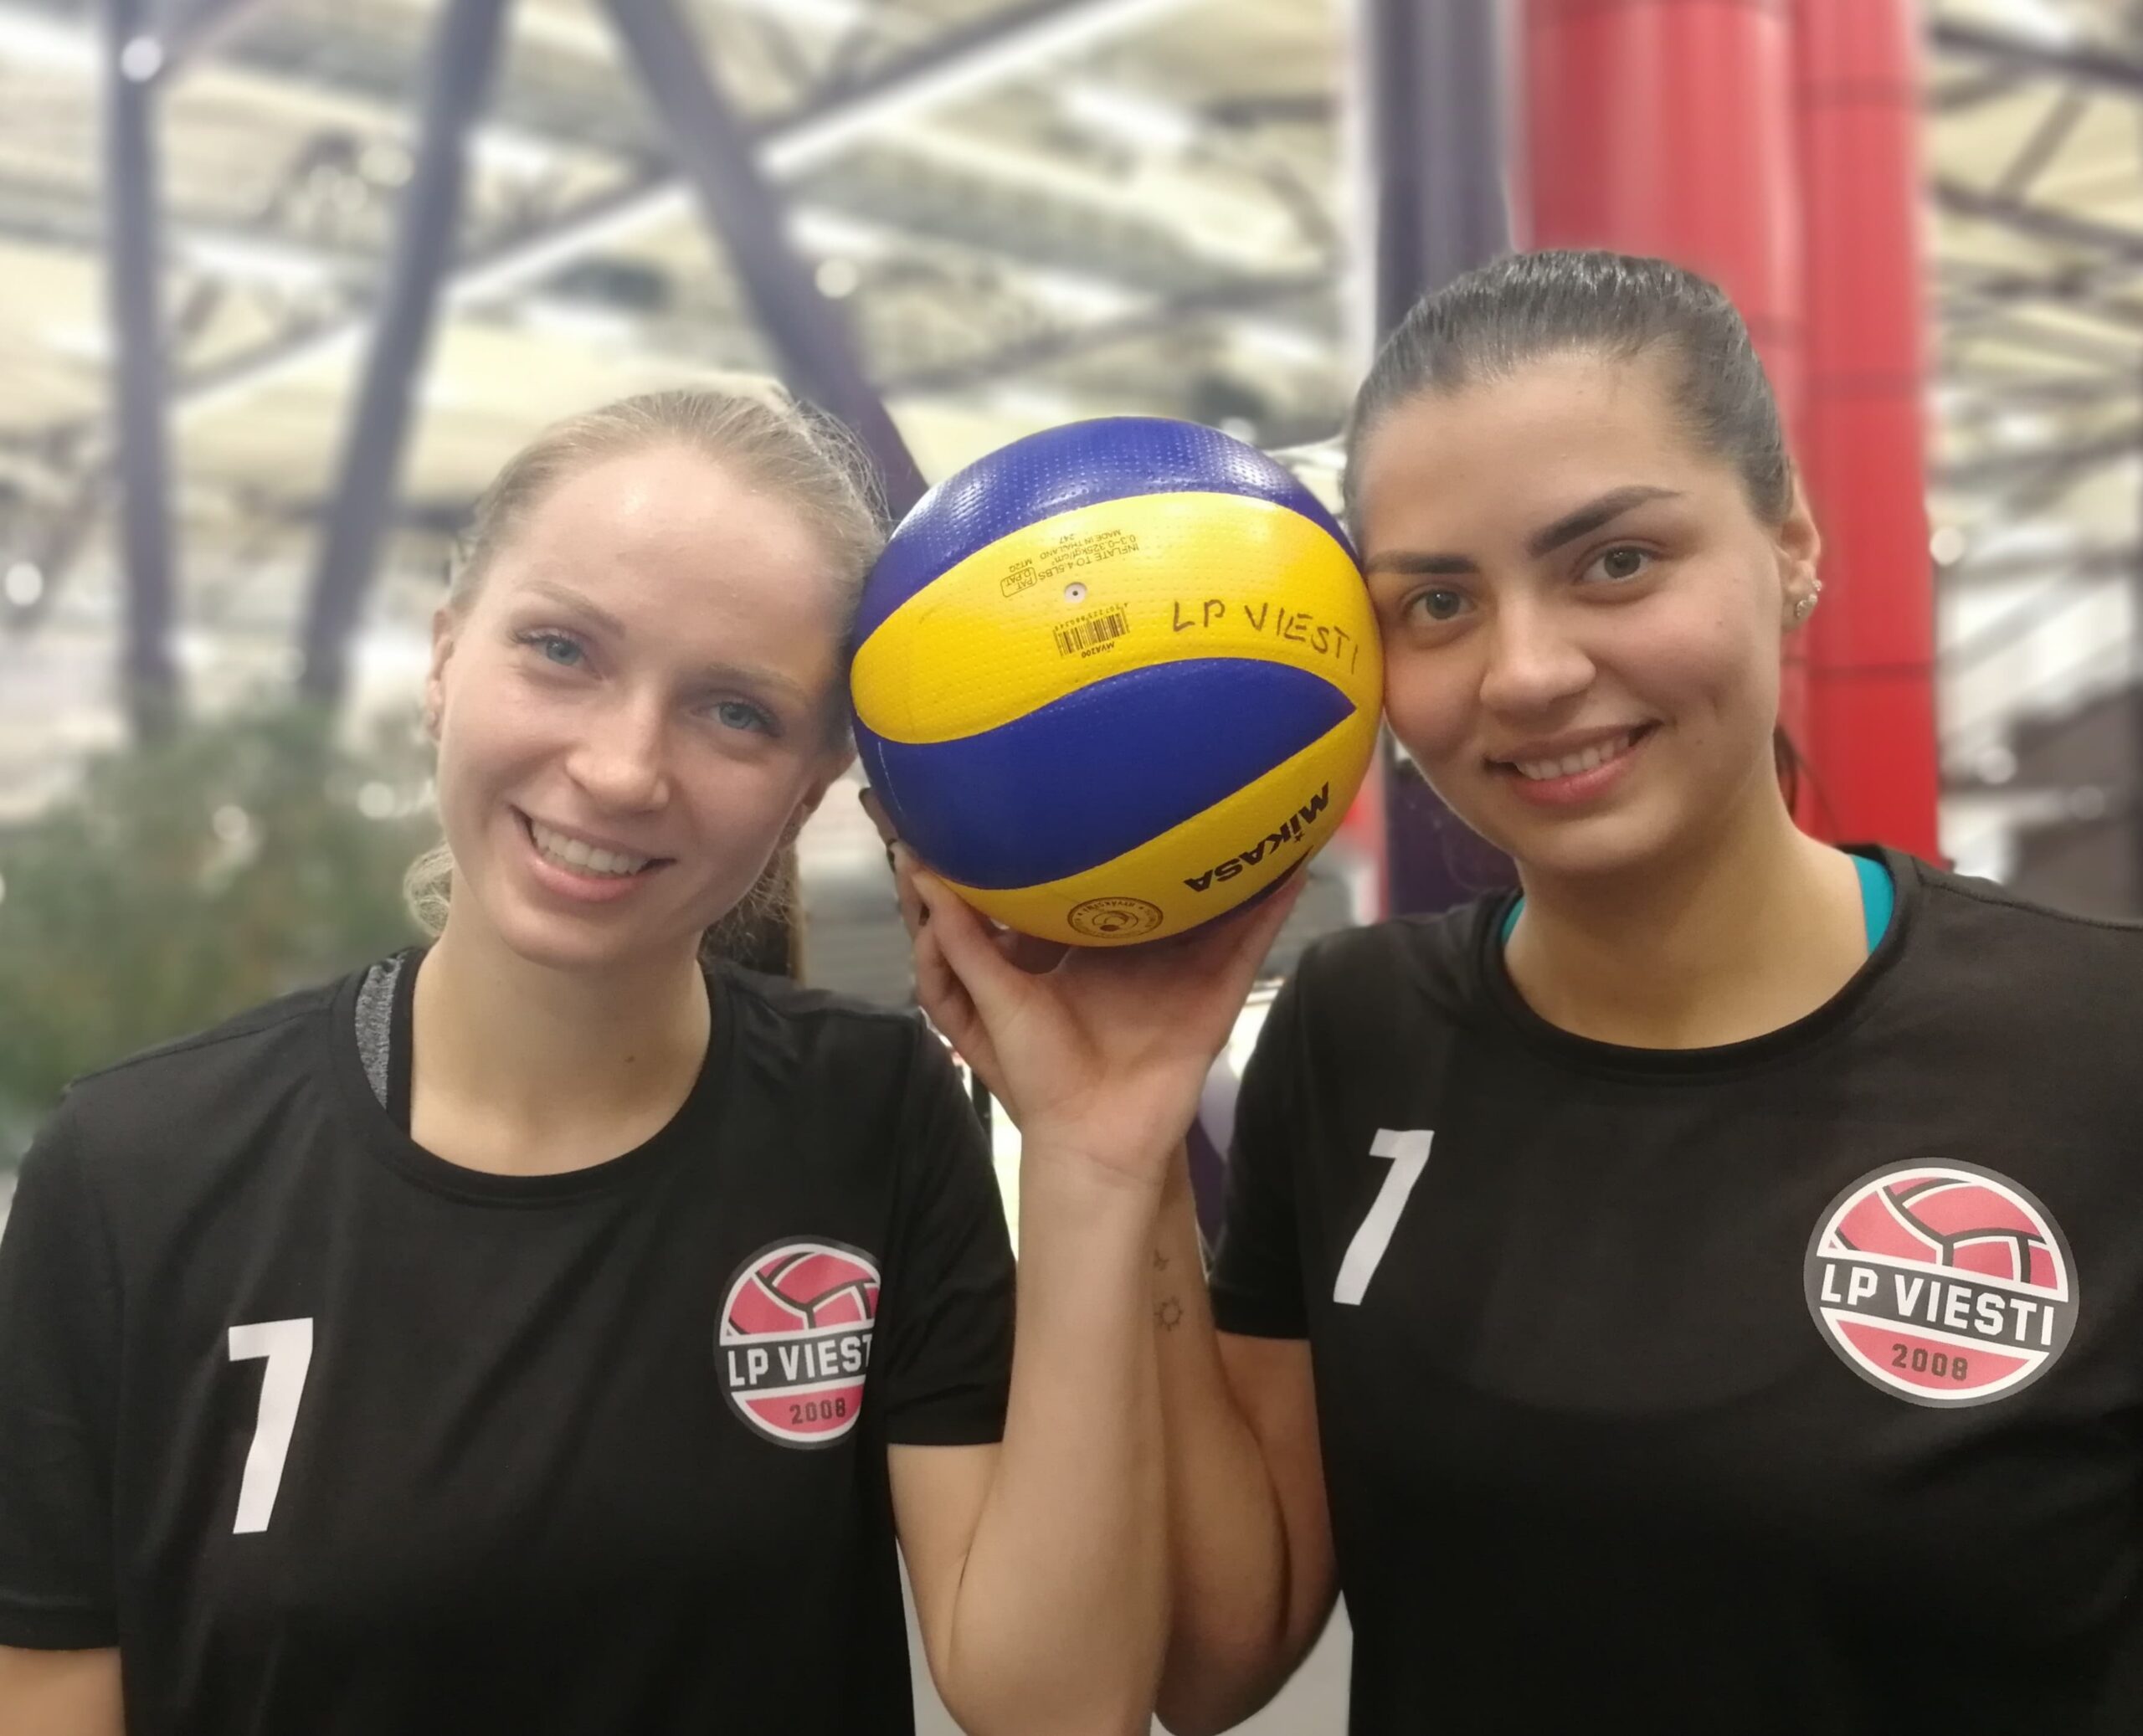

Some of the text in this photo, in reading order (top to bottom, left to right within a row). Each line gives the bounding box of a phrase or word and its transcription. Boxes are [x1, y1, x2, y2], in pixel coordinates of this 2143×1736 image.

[1040, 529, 1122, 560] MADE IN THAILAND
[1077, 557, 1092, 567] TO
[1095, 542, 1139, 562] INFLATE
[1082, 641, 1115, 658] MVA200
[1173, 599, 1359, 675] LP VIESTI
[1183, 781, 1328, 892] MIKASA
[1334, 1127, 1435, 1306] 7
[1821, 1263, 2054, 1346] LP VIESTI
[727, 1333, 872, 1387] LP VIEST
[1892, 1343, 1968, 1381] 2008
[229, 1317, 313, 1534] 7
[789, 1397, 846, 1425] 2008
